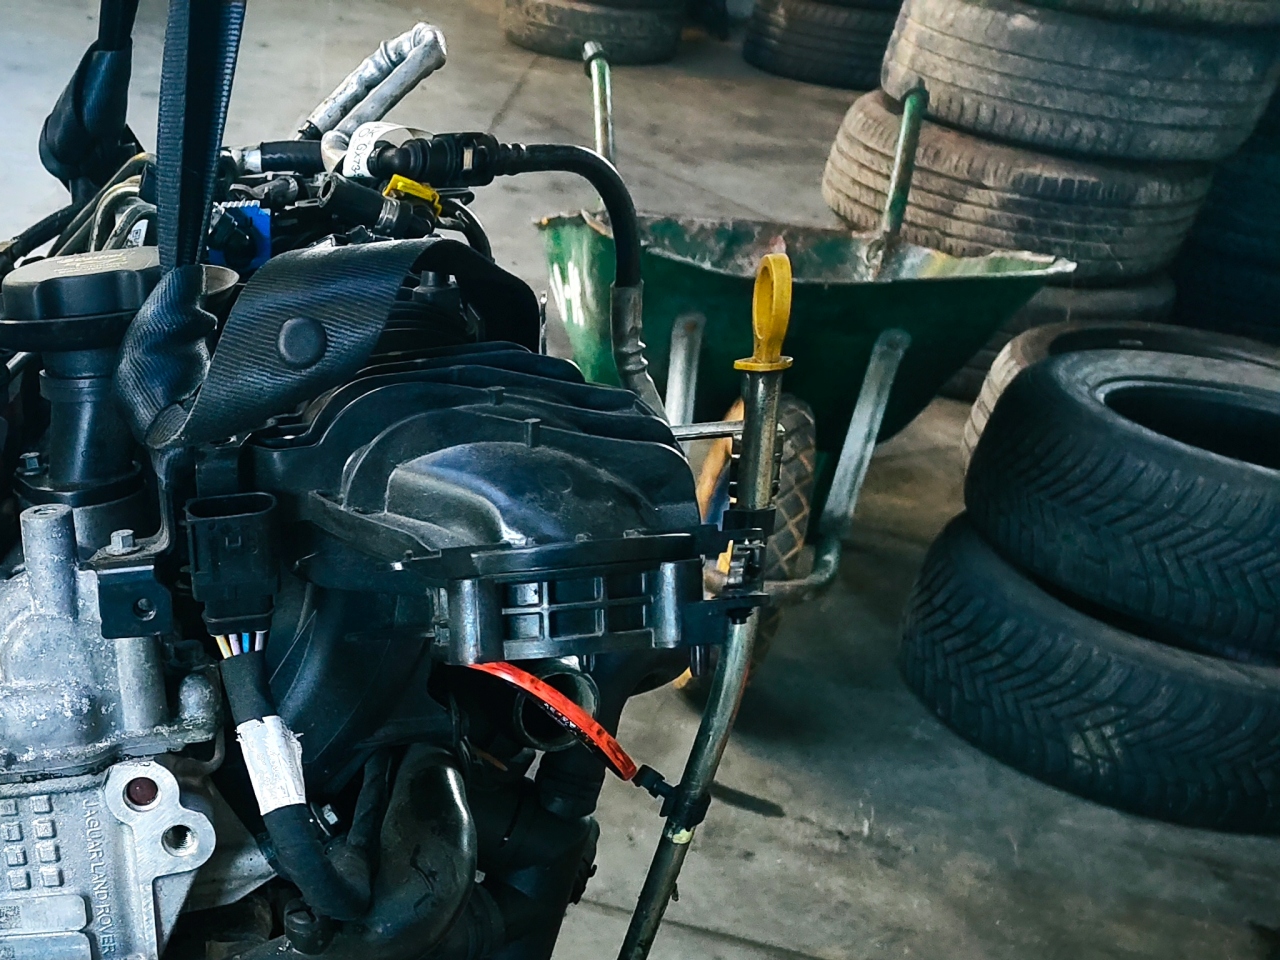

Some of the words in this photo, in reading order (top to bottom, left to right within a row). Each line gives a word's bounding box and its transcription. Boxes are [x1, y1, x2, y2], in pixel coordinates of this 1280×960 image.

[83, 799, 104, 860] JAGUAR
[91, 861, 110, 901] LAND
[95, 904, 116, 955] ROVER
